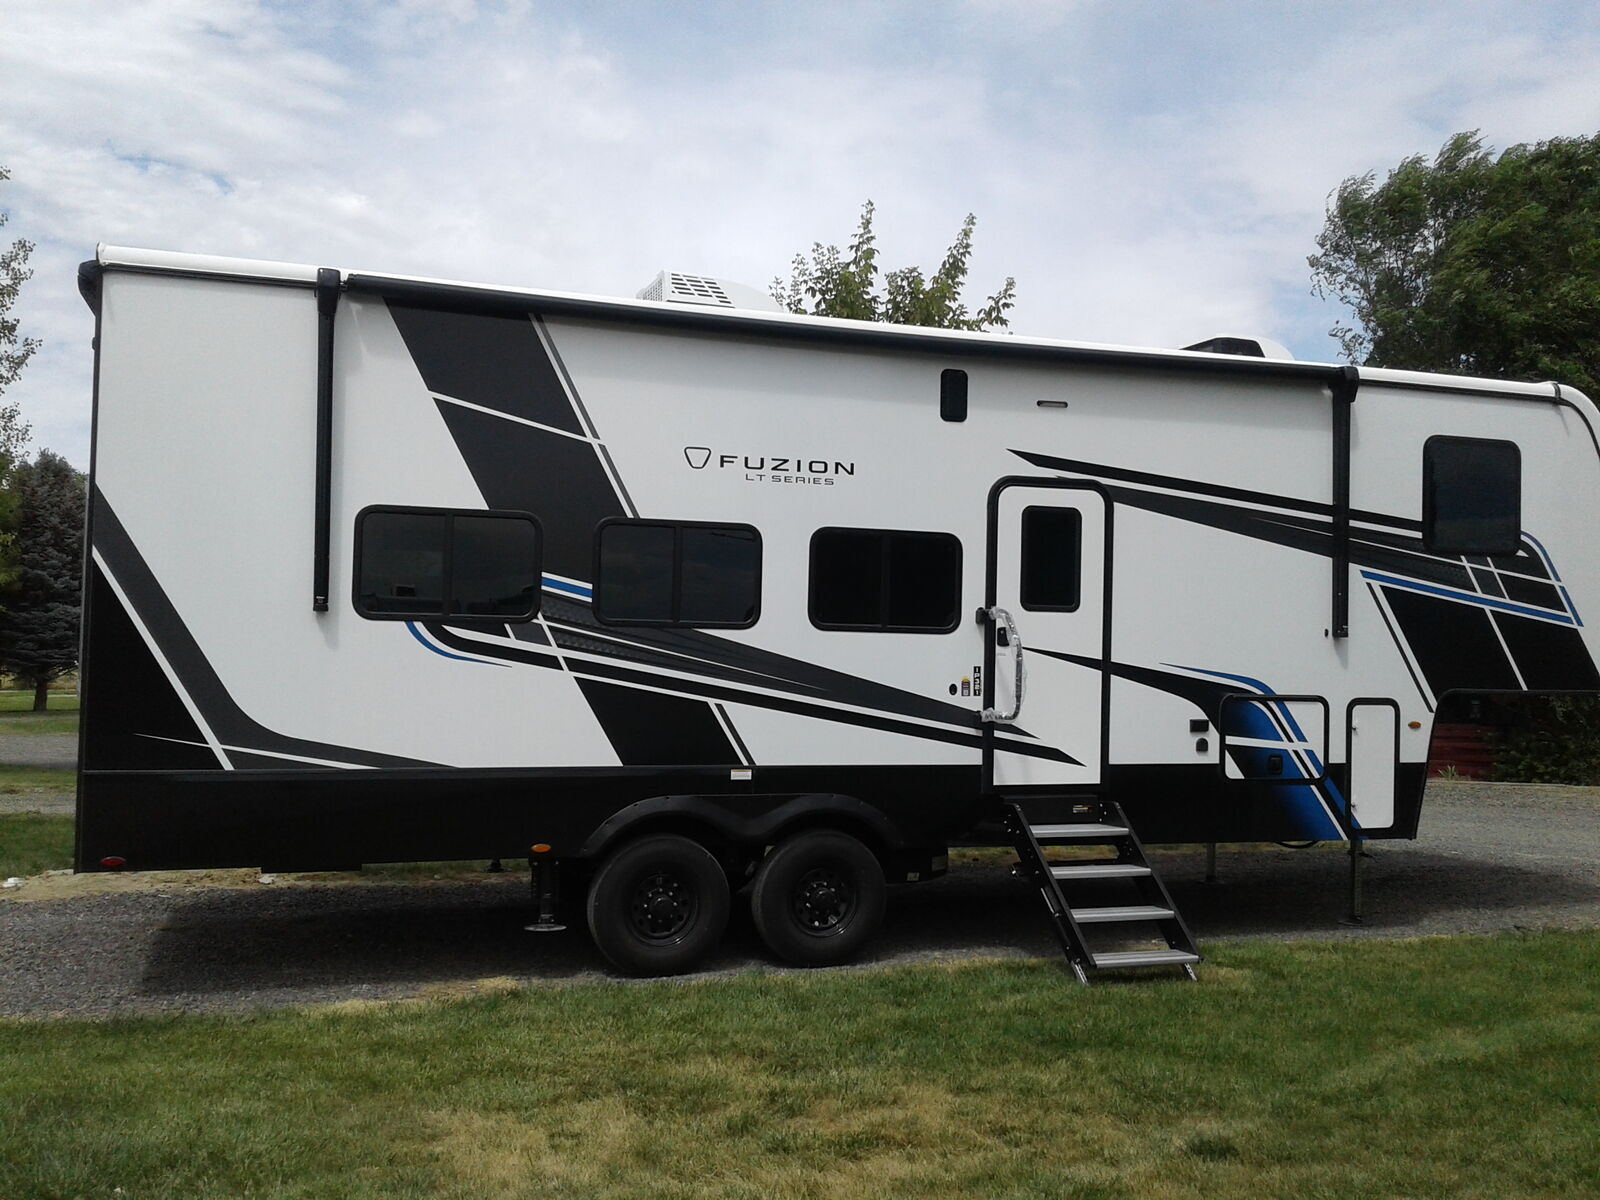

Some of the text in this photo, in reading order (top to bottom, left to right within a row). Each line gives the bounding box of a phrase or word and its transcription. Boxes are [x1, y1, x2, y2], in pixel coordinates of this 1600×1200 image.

[719, 455, 855, 475] FUZION
[745, 473, 834, 485] LT SERIES
